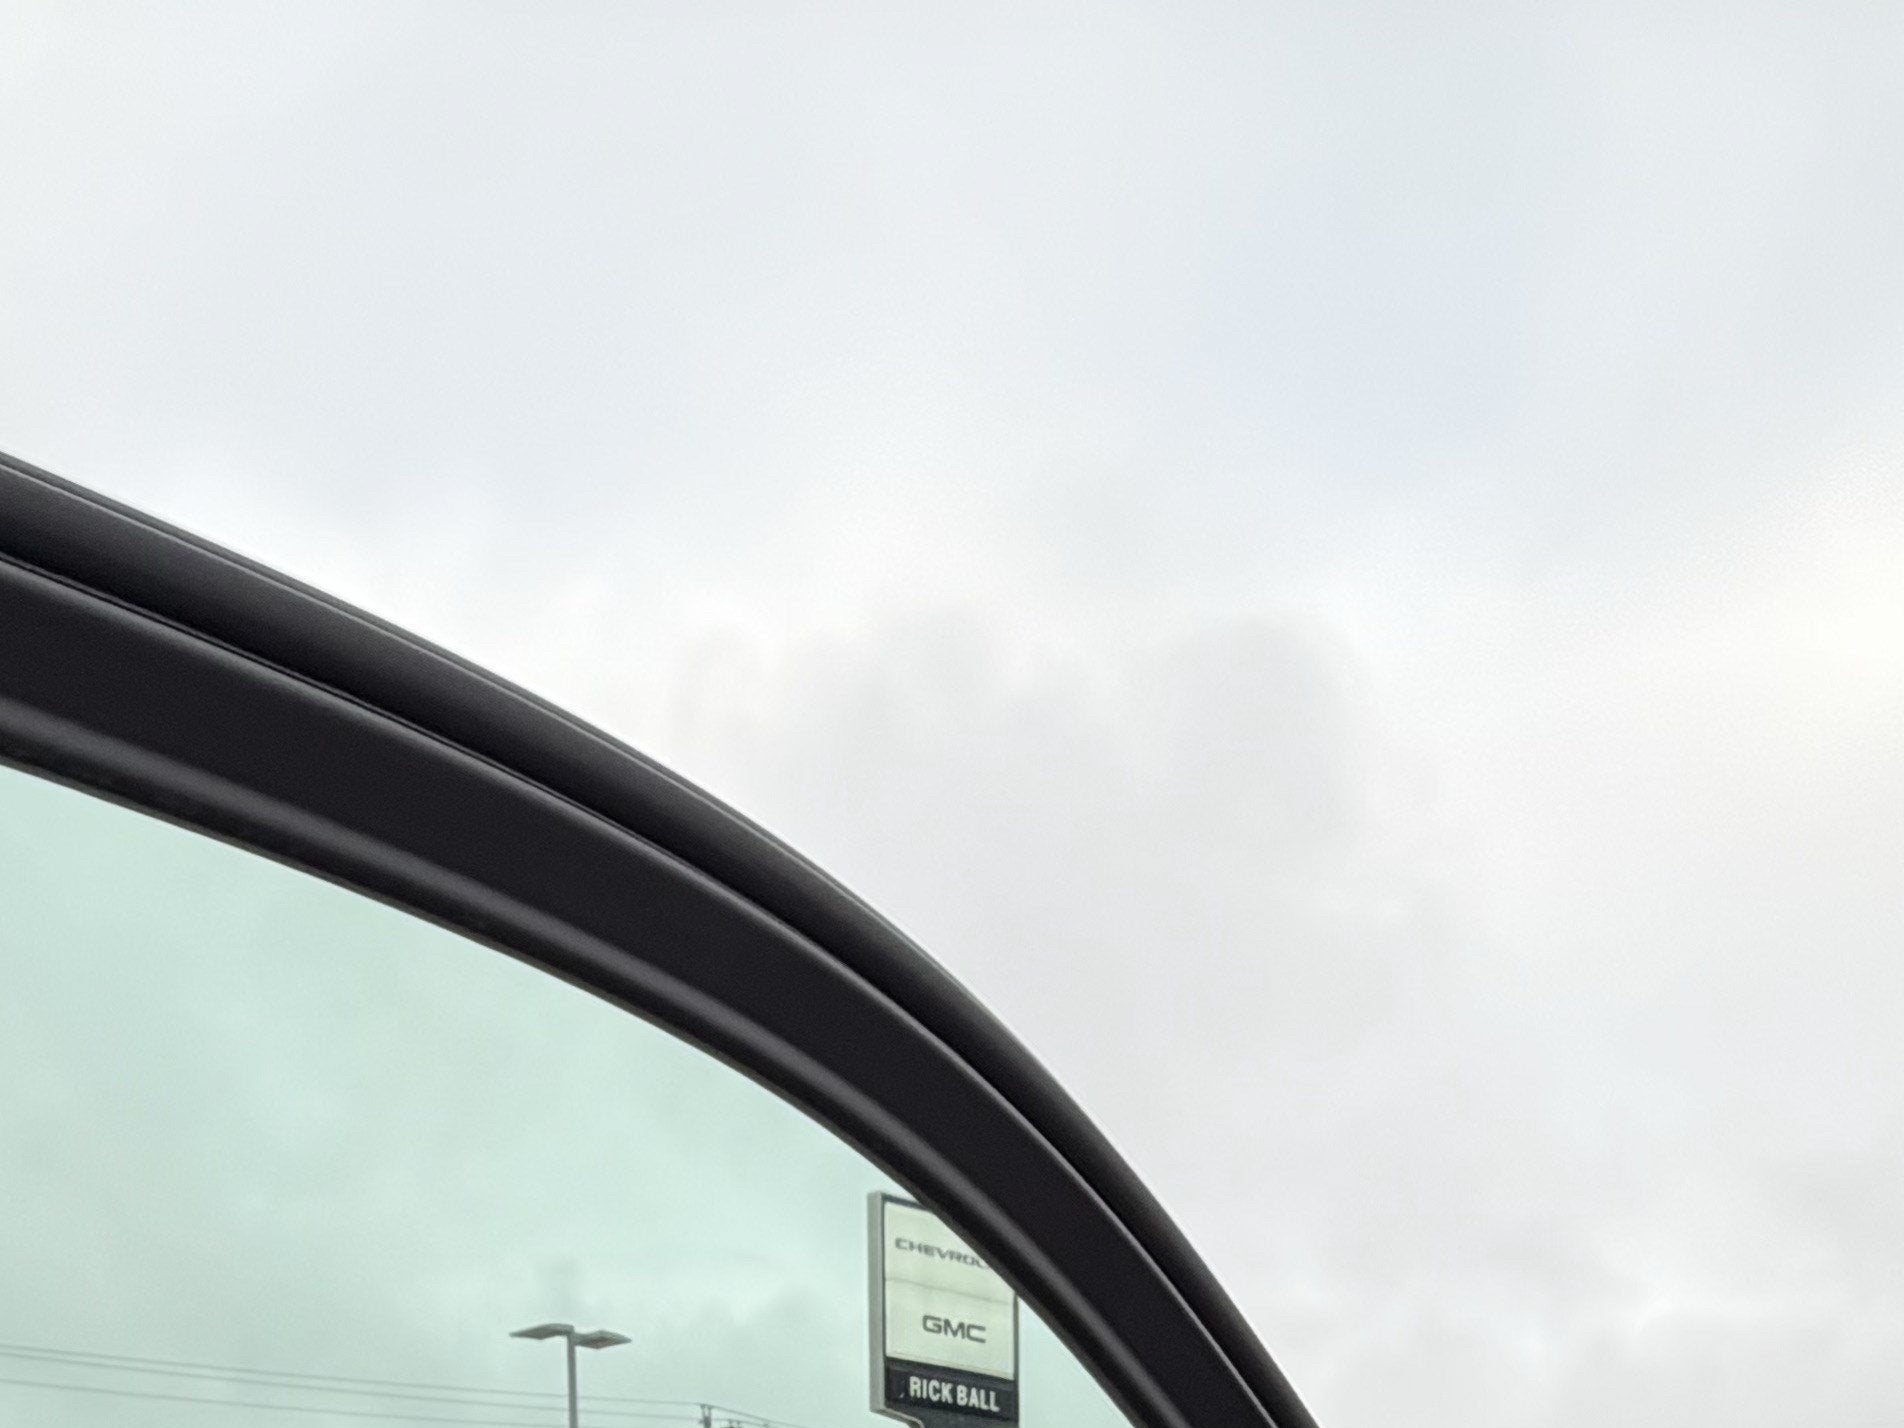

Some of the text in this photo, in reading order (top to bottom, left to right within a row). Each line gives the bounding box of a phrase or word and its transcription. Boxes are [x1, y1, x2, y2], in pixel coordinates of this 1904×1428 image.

[922, 1314, 986, 1343] GMC
[909, 1376, 1000, 1412] RICK BALL
